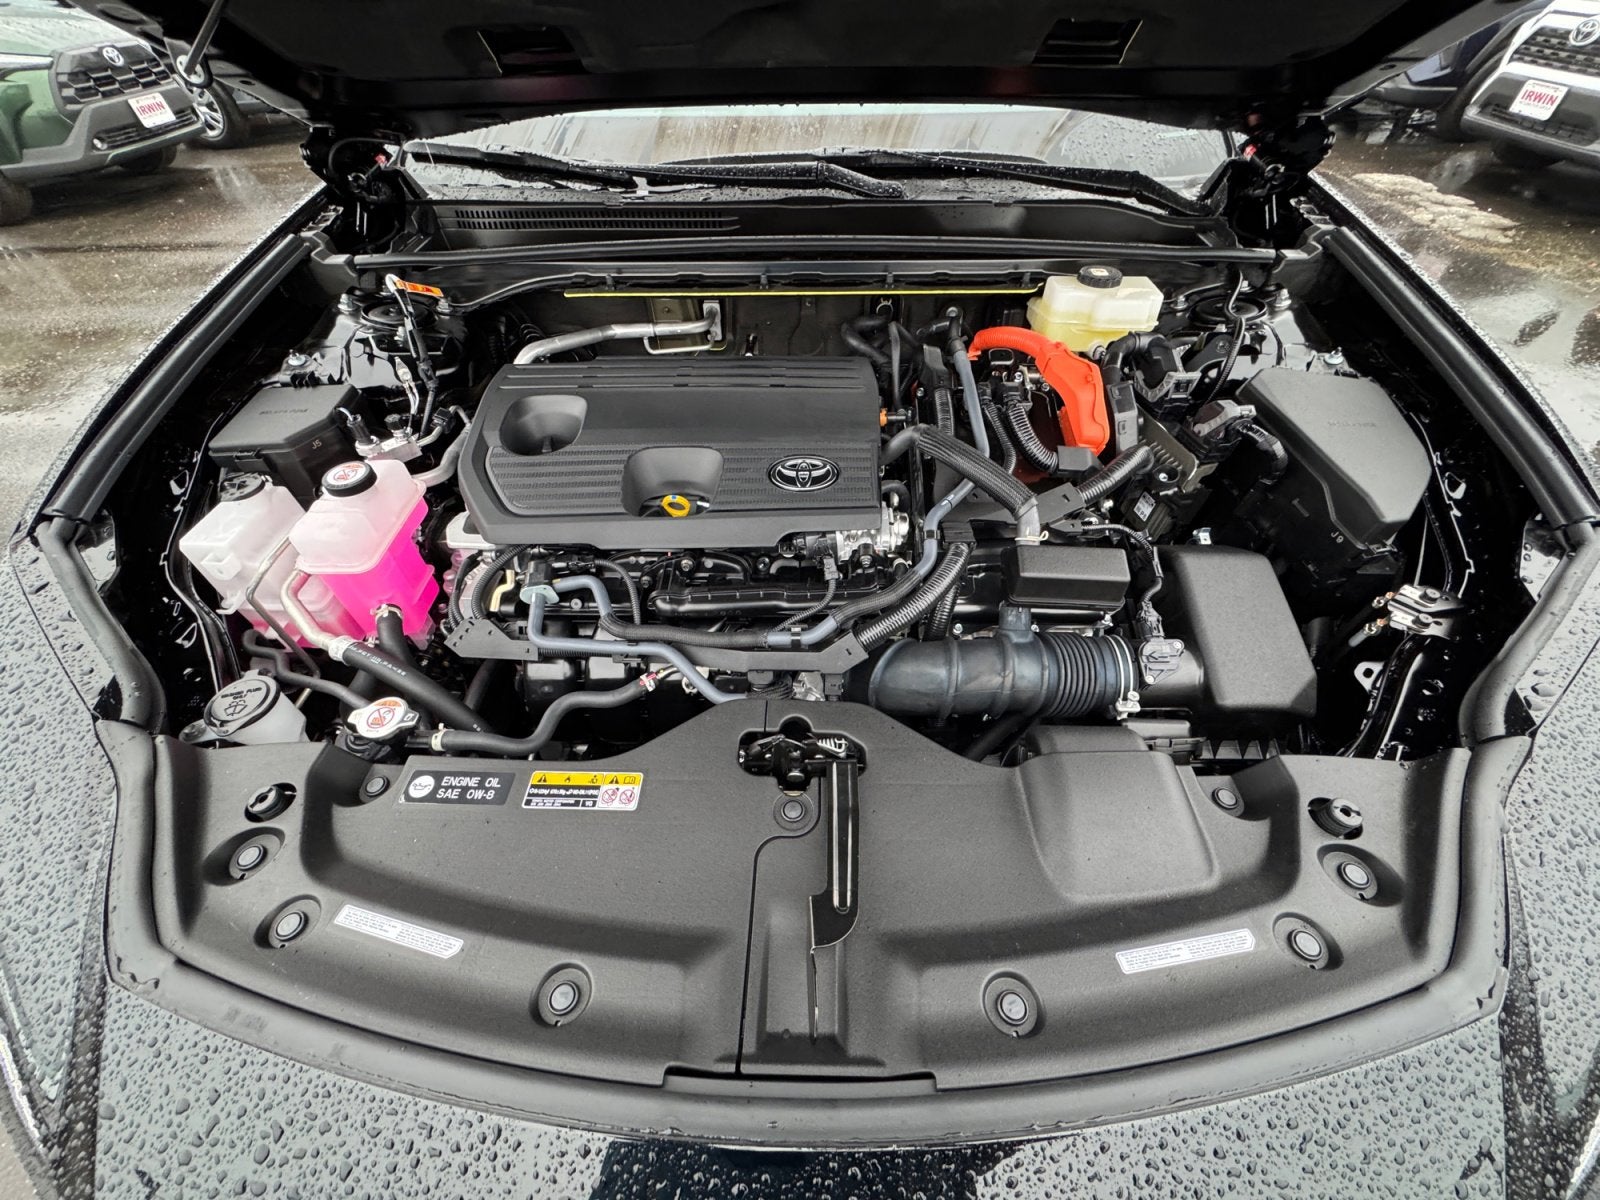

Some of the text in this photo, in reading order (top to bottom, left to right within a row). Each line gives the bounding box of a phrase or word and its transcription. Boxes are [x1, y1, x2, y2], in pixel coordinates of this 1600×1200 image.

[1521, 90, 1559, 106] IRWIN
[136, 101, 165, 116] IRWIN
[441, 776, 502, 788] ENGINE OIL
[436, 788, 496, 800] SAE 0W-8
